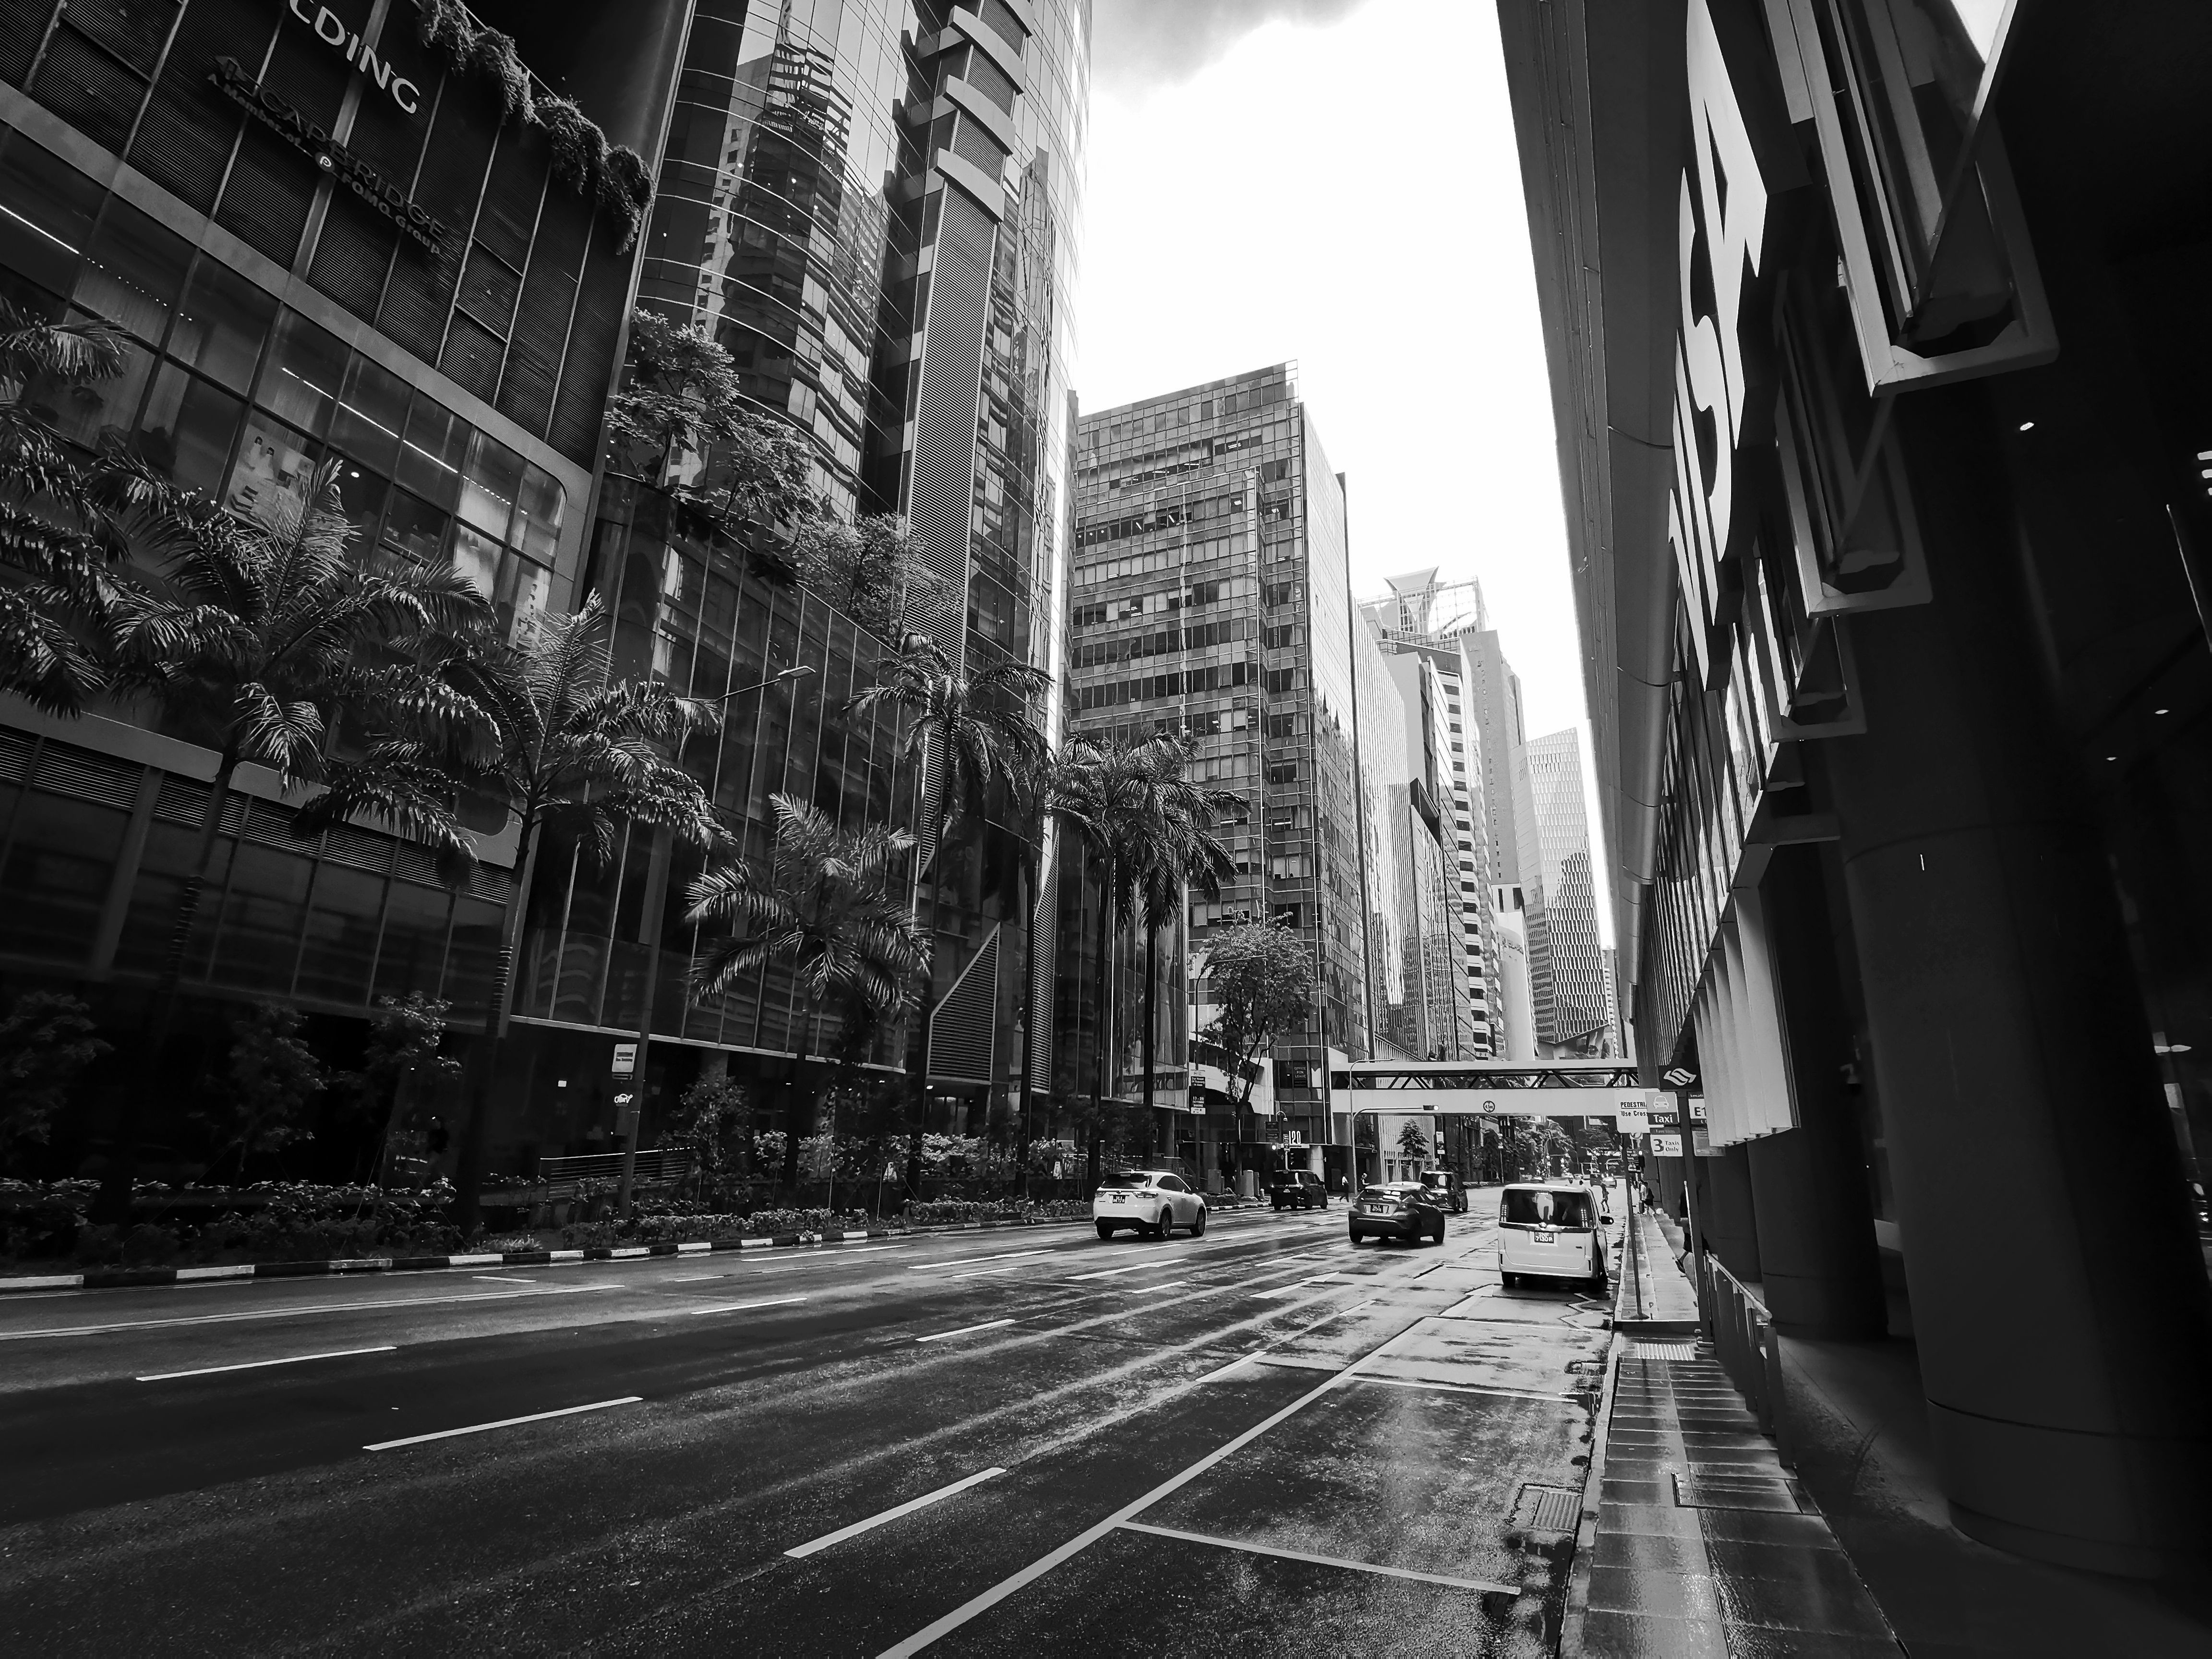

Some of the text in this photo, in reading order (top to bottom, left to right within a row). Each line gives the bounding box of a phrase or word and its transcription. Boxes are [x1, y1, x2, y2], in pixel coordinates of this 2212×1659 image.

[395, 214, 440, 255] Group
[1668, 0, 1767, 692] VISA
[1653, 1114, 1673, 1123] Taxi
[1288, 1130, 1301, 1144] 120
[1653, 1138, 1664, 1152] 3
